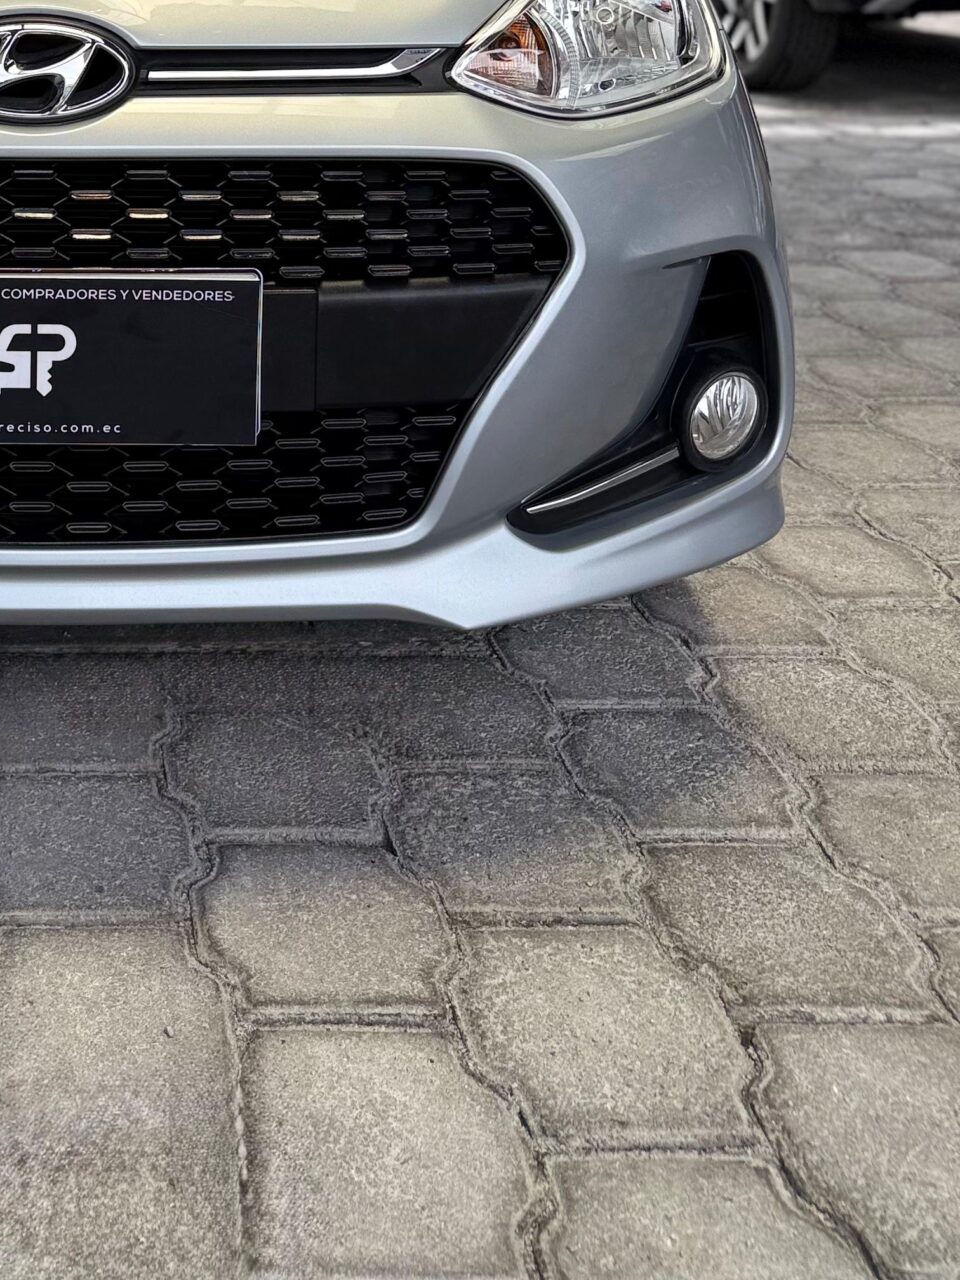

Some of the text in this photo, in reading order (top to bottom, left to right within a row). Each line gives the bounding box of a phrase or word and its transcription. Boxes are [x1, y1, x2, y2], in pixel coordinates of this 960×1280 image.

[1, 288, 117, 301] COMPRADORES
[120, 289, 129, 300] Y
[131, 289, 233, 302] VENDEDORES
